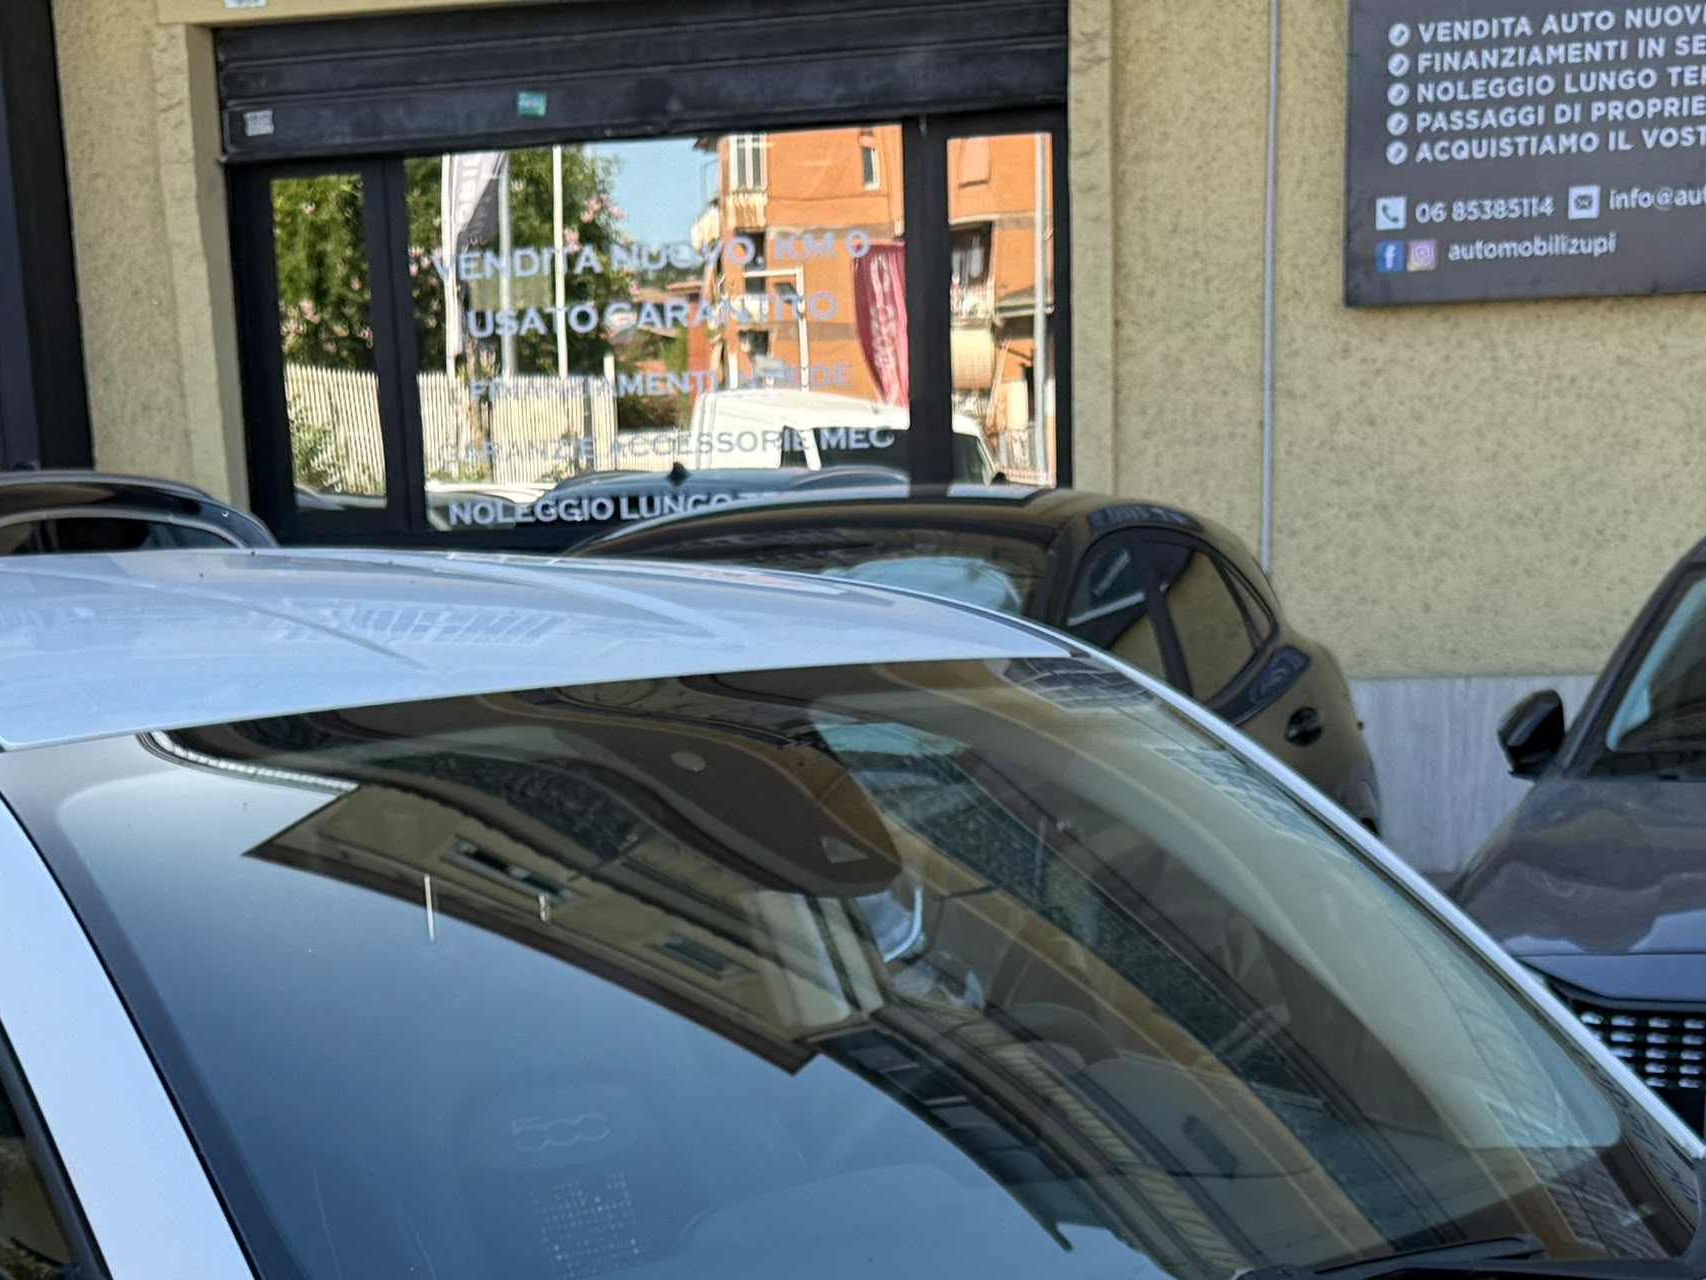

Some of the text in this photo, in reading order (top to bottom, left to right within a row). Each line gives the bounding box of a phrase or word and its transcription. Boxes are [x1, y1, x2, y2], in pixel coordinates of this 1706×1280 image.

[1418, 16, 1533, 43] VENDITA
[1542, 10, 1616, 36] AUTO
[1418, 39, 1629, 74] FINANZIAMENTI
[1638, 37, 1666, 60] IN
[1417, 74, 1556, 103] NOLEGGIO
[1564, 68, 1658, 94] LUNGO
[1415, 104, 1545, 133] PASSAGGI
[1554, 102, 1582, 125] DI
[1415, 131, 1600, 163] ACQUISTIAMO
[1608, 130, 1634, 151] IL
[1415, 203, 1447, 224] 06
[432, 243, 604, 281] VENDITA
[774, 232, 835, 262] KM
[1447, 231, 1617, 262] automobilizupi
[468, 291, 838, 338] USATO GARANTITO
[448, 497, 616, 525] NOLEGGIO
